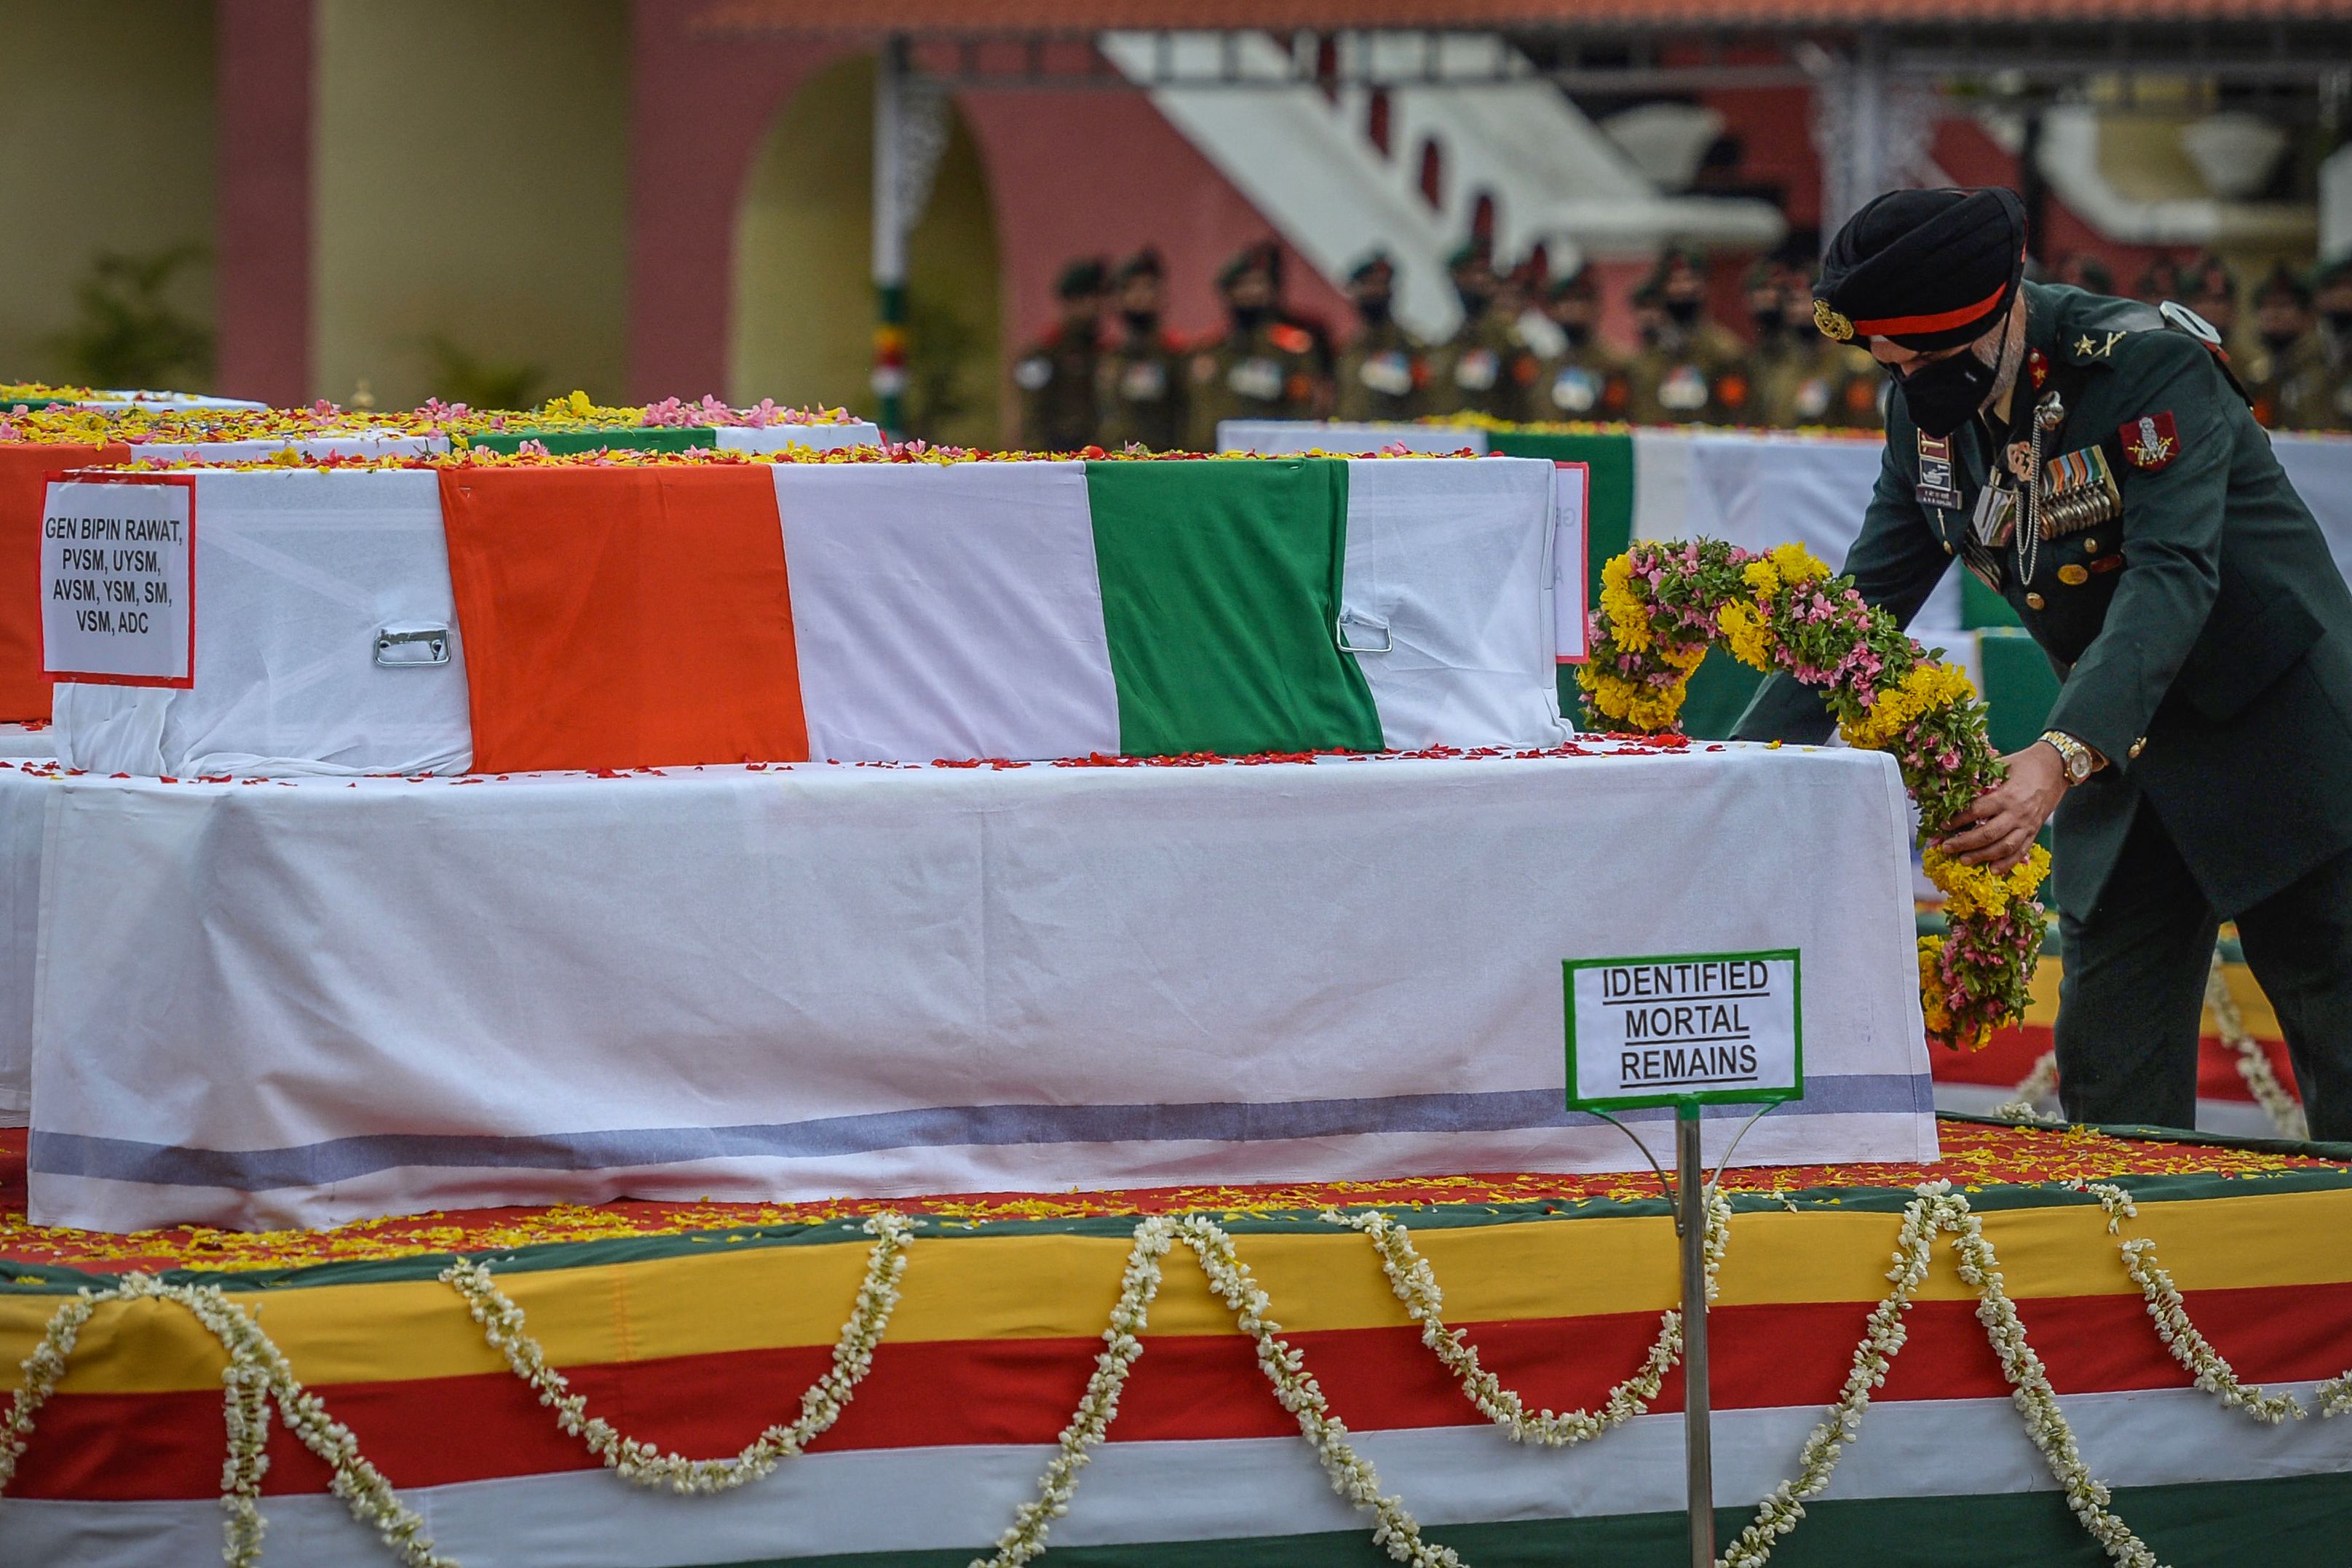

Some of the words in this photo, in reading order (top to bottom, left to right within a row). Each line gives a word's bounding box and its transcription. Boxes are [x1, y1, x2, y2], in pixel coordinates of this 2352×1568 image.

[45, 517, 77, 539] GEN
[81, 518, 121, 541] BIPIN
[125, 519, 182, 546] RAWAT,
[63, 548, 108, 575] PVSM,
[113, 550, 161, 577] UYSM,
[53, 578, 100, 606] AVSM,
[102, 579, 140, 606] YSM,
[144, 581, 172, 608] SM,
[76, 609, 115, 637] VSM,
[118, 611, 149, 634] ADC
[1603, 960, 1768, 998] IDENTIFIED
[1626, 1004, 1750, 1038] MORTAL
[1621, 1045, 1757, 1081] REMAINS
